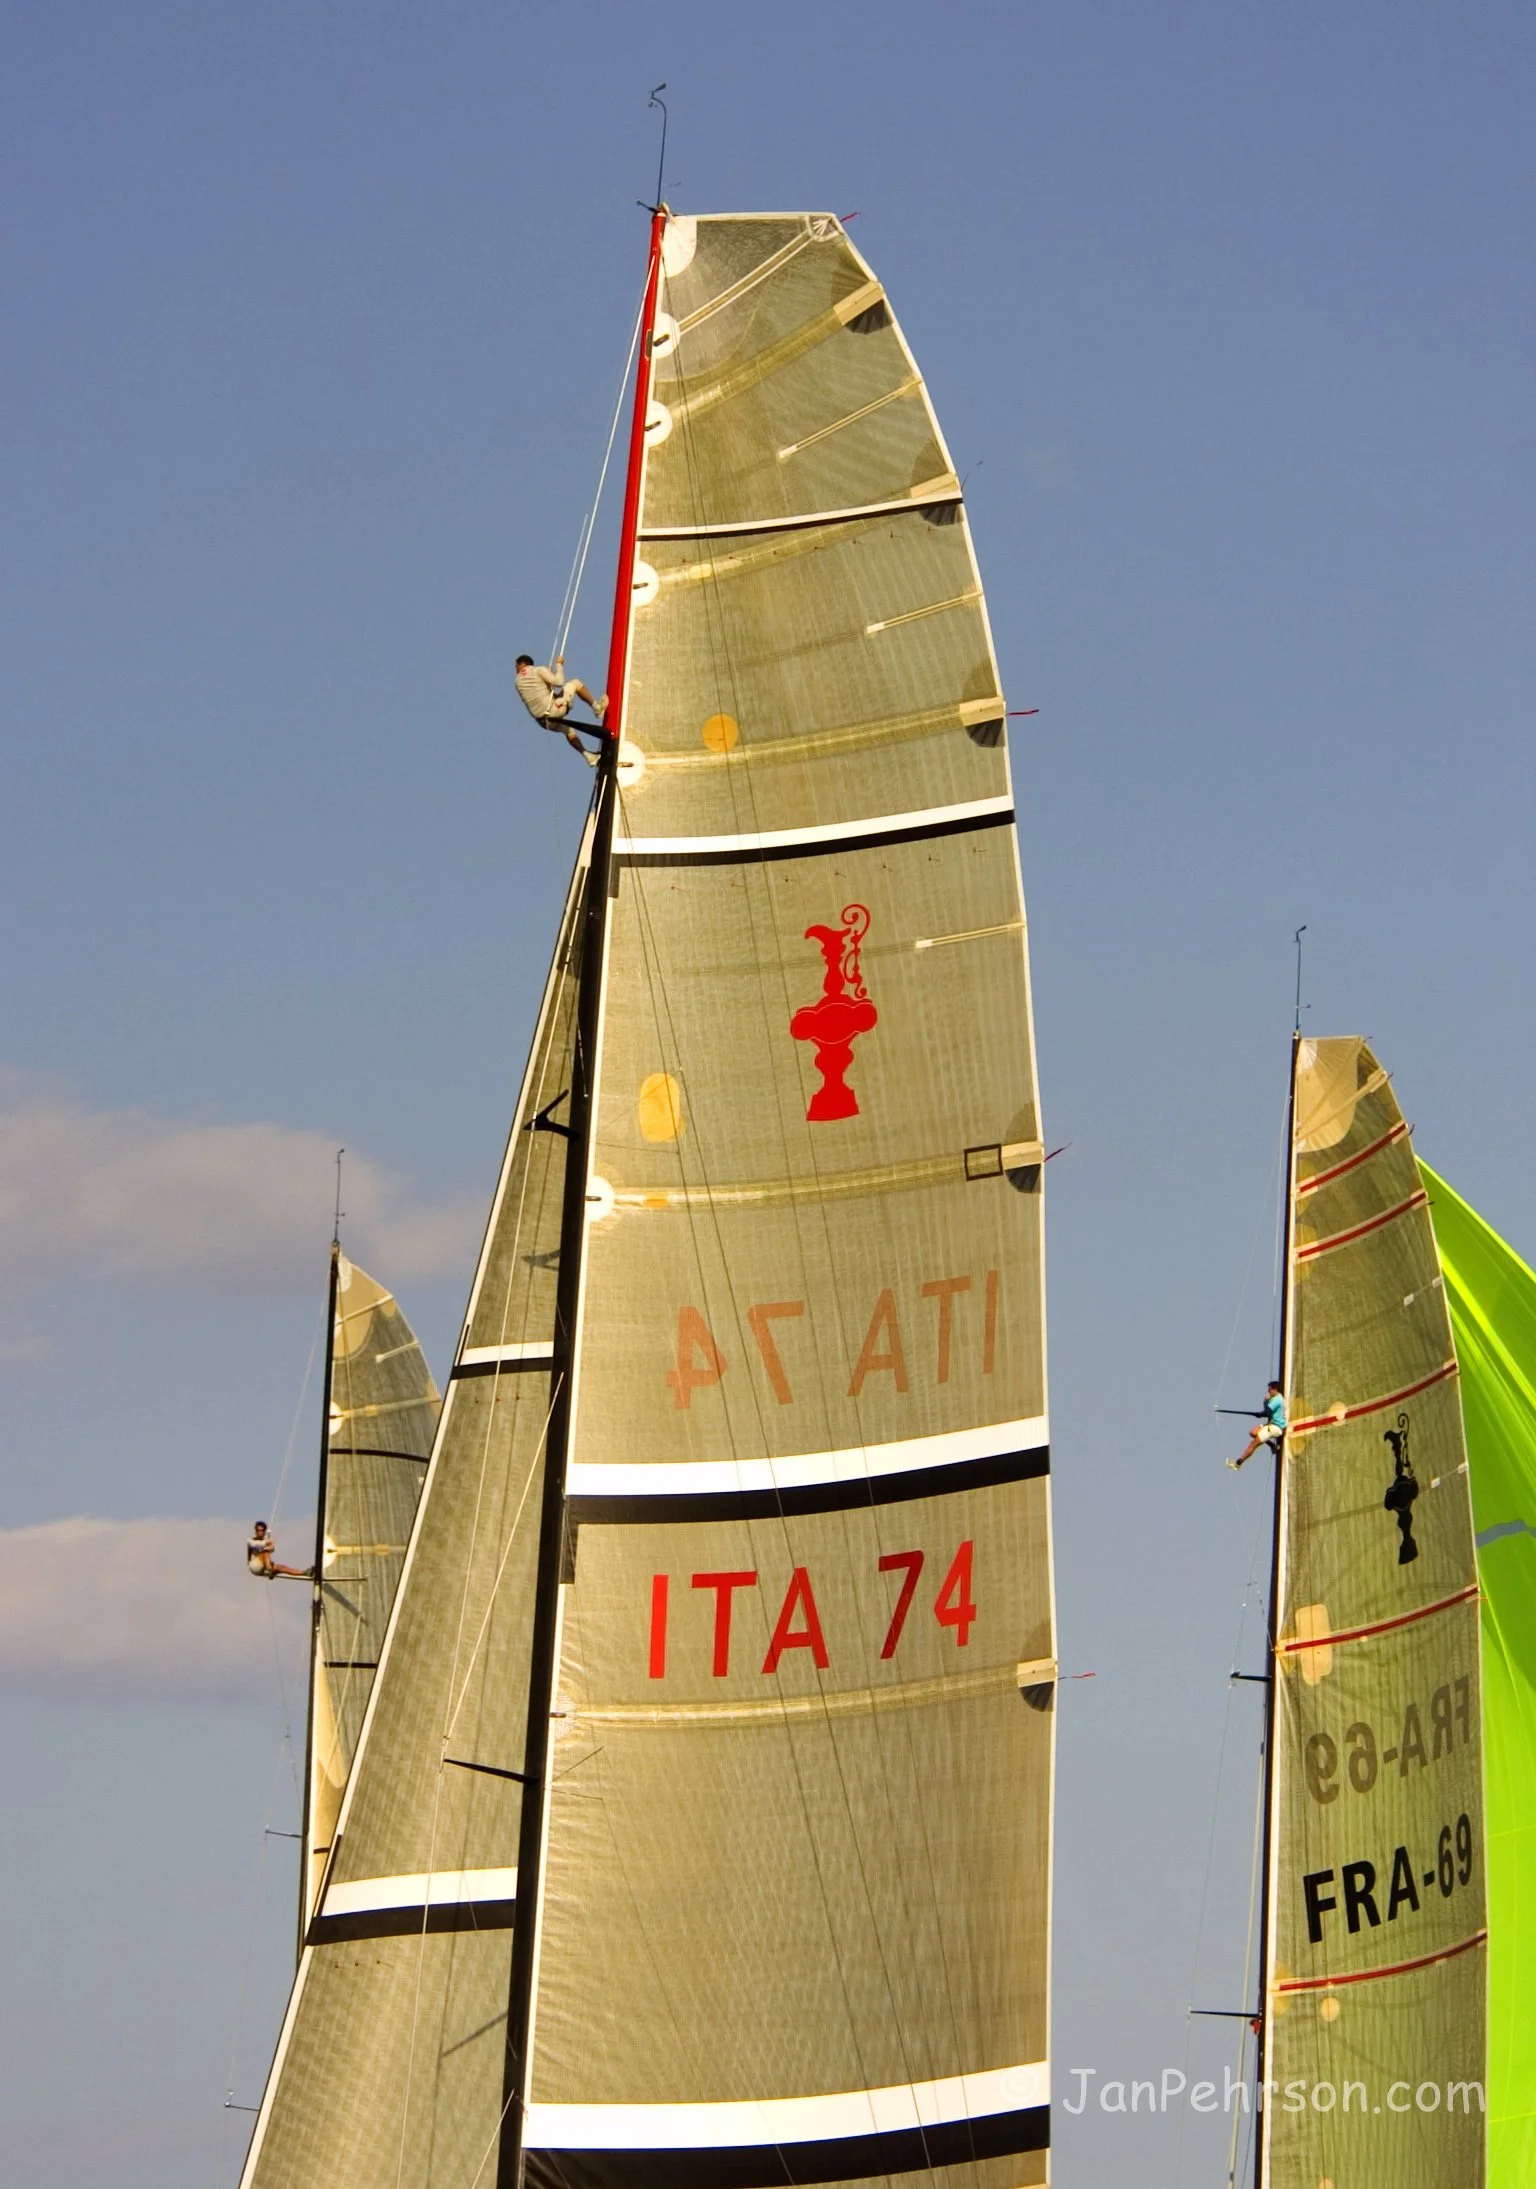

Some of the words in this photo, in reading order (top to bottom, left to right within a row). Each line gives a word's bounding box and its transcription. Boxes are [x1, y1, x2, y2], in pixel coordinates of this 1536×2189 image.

[648, 1566, 830, 1679] ITA
[878, 1540, 977, 1660] 74
[1302, 1812, 1473, 1945] FRA-69
